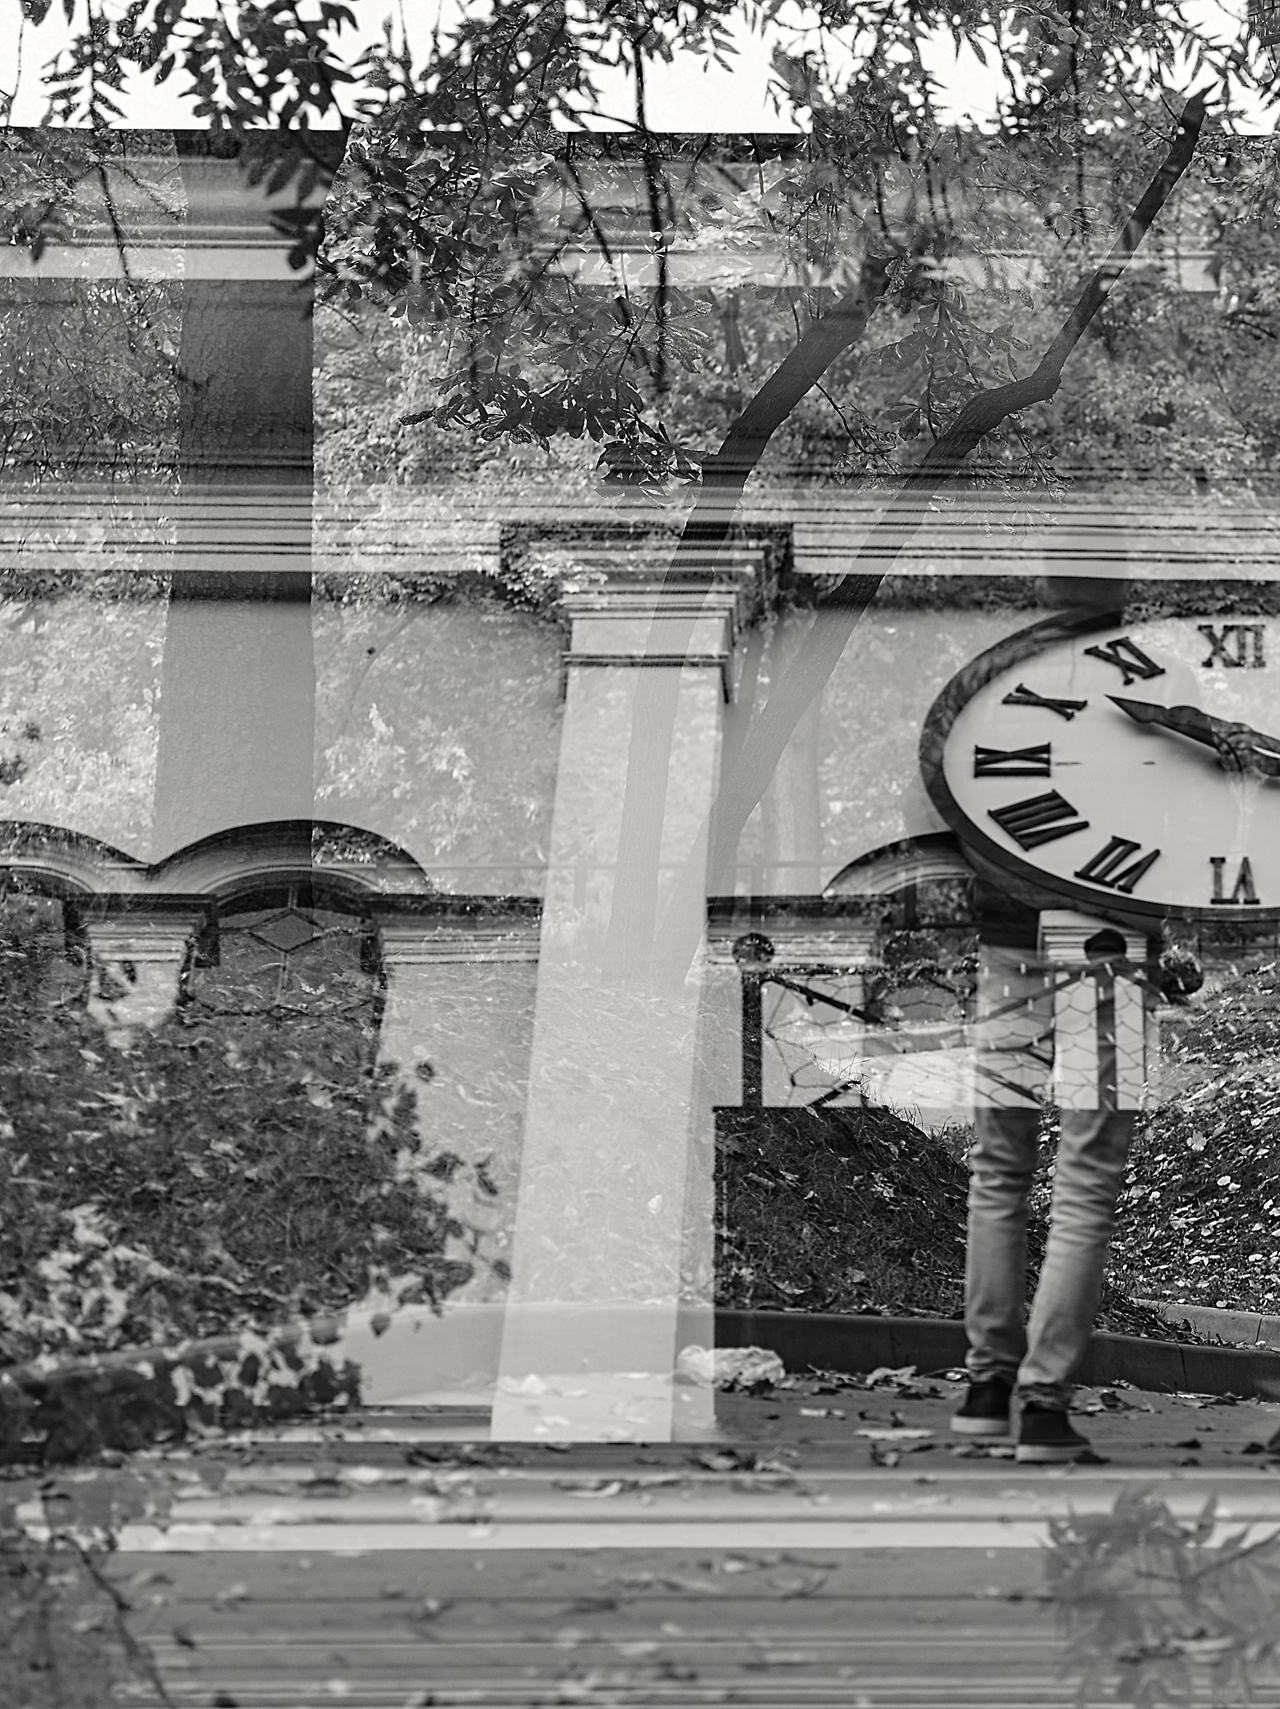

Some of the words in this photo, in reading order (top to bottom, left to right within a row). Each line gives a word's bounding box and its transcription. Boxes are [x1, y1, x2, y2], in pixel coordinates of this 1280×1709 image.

[1084, 636, 1165, 685] XI
[1198, 624, 1266, 668] XII
[1002, 683, 1087, 721] X
[974, 742, 1051, 778] IX
[987, 789, 1089, 851] VIII
[1074, 835, 1160, 893] VII
[1210, 857, 1260, 904] VI
